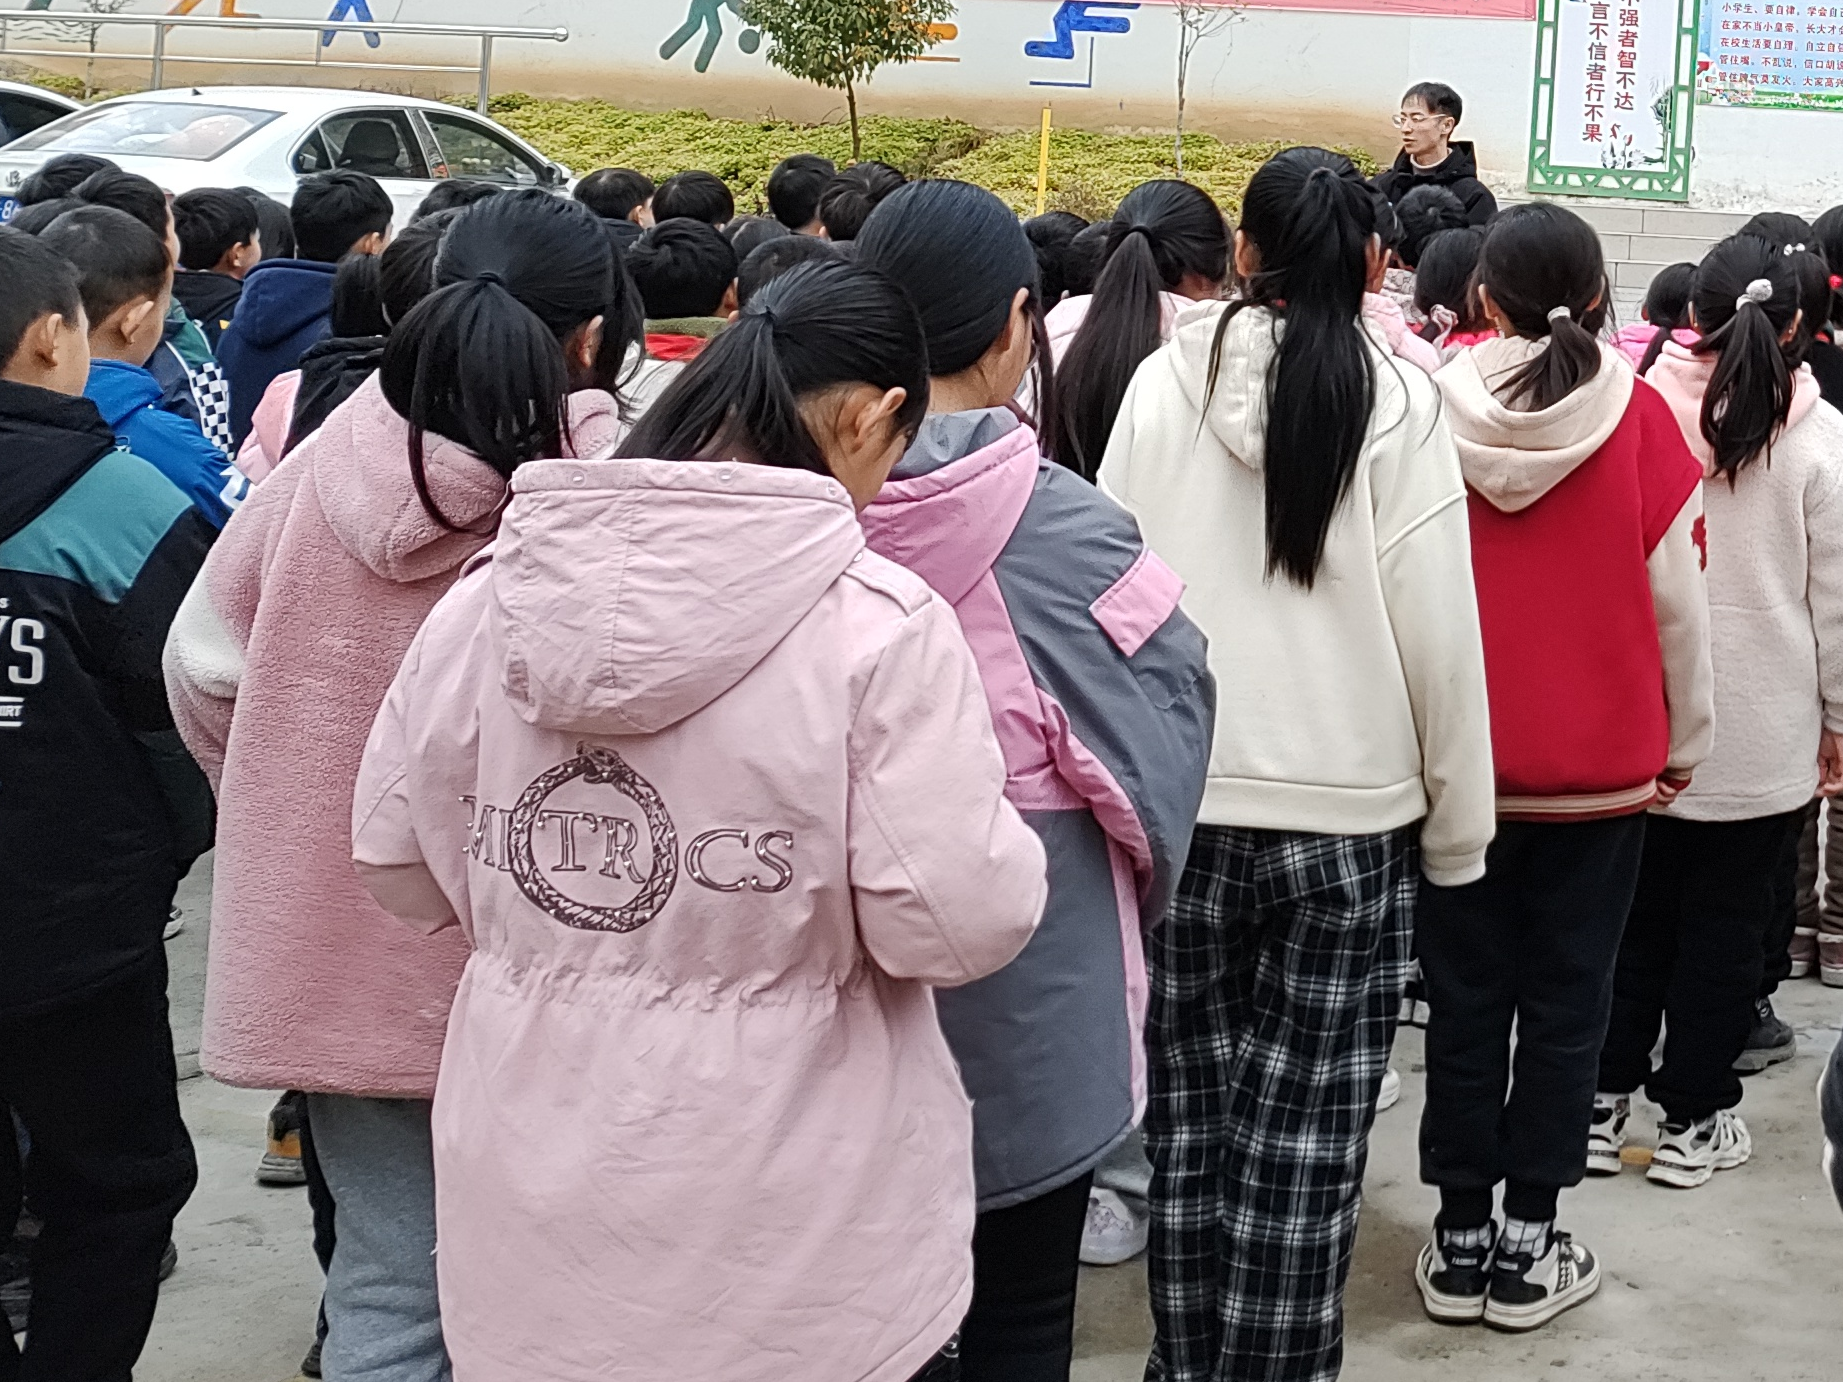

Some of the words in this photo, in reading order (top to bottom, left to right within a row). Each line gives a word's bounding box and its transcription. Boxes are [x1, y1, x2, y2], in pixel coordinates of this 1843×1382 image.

[1581, 0, 1611, 143] 言不信者行不果
